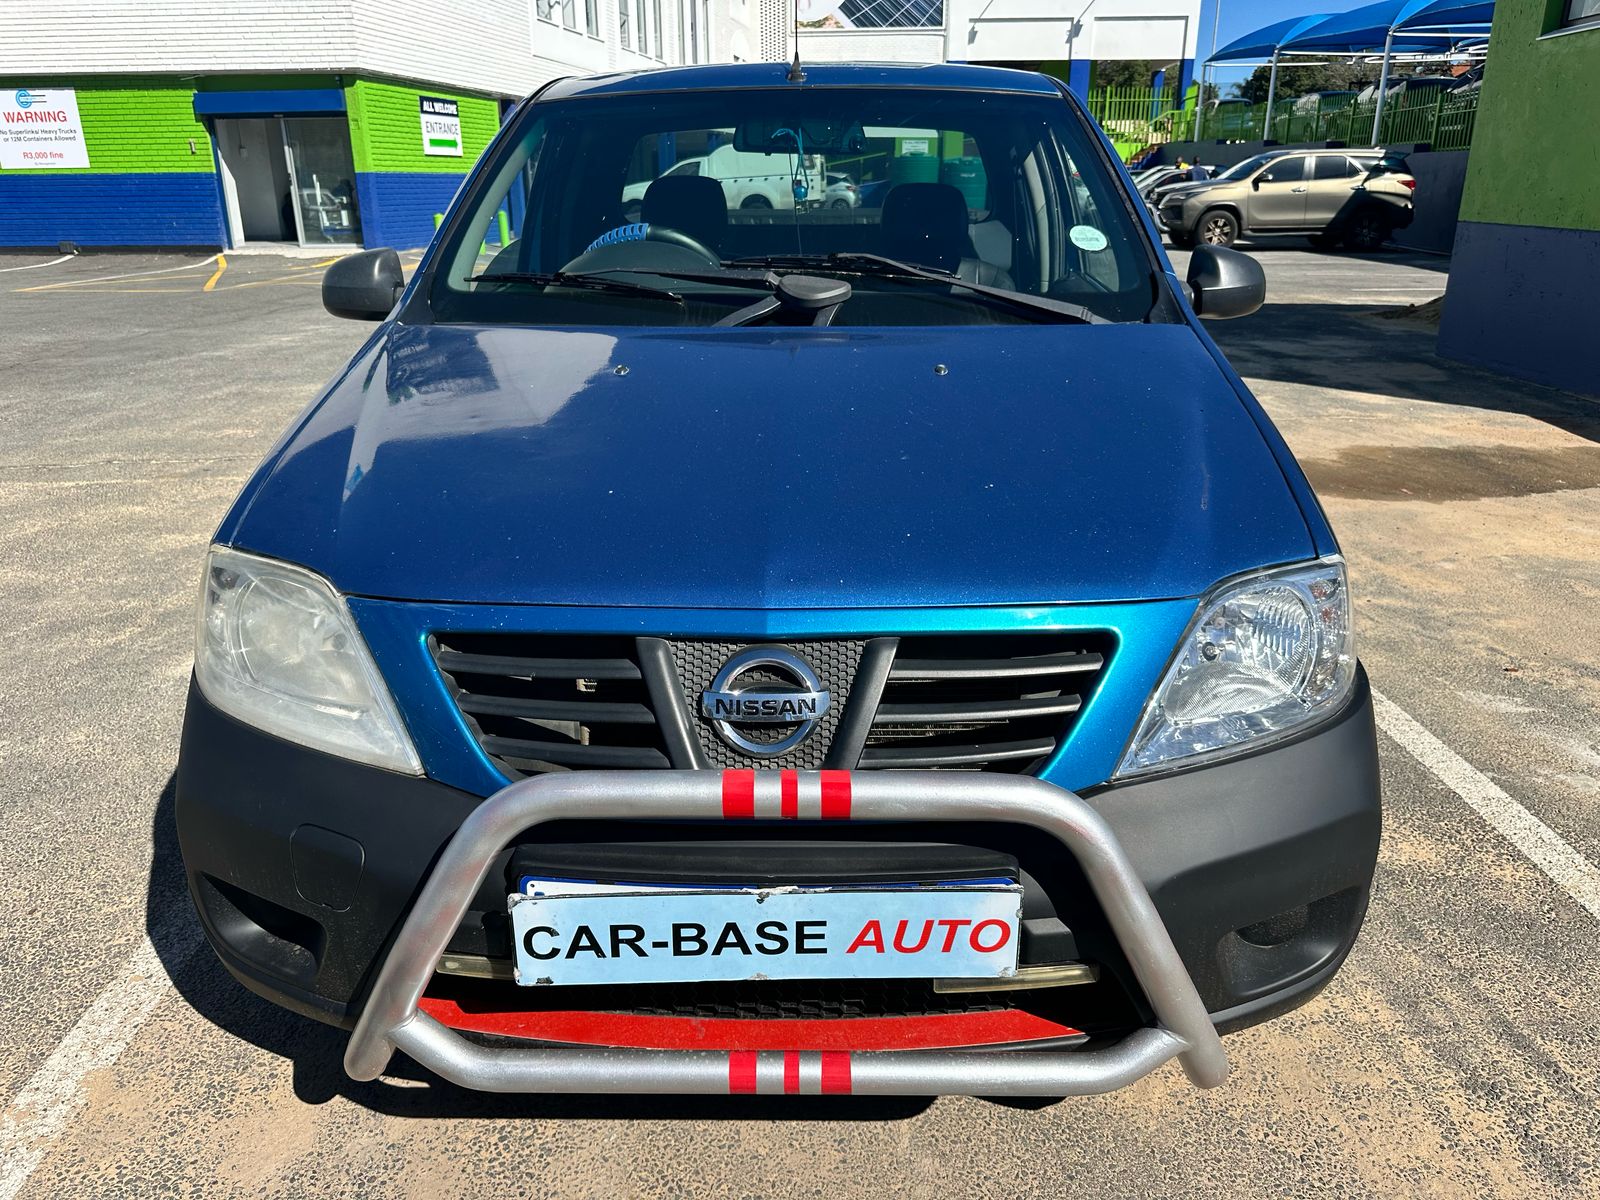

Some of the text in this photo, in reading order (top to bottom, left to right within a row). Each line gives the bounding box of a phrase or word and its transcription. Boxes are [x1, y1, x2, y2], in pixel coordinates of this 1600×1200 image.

[423, 101, 458, 114] ALL WELCOME
[3, 111, 67, 123] WARNING
[425, 121, 459, 135] ENTRANCE
[23, 152, 48, 160] R3,000
[715, 698, 816, 716] NISSAN
[522, 918, 1012, 960] CAR-BASE AUTO
